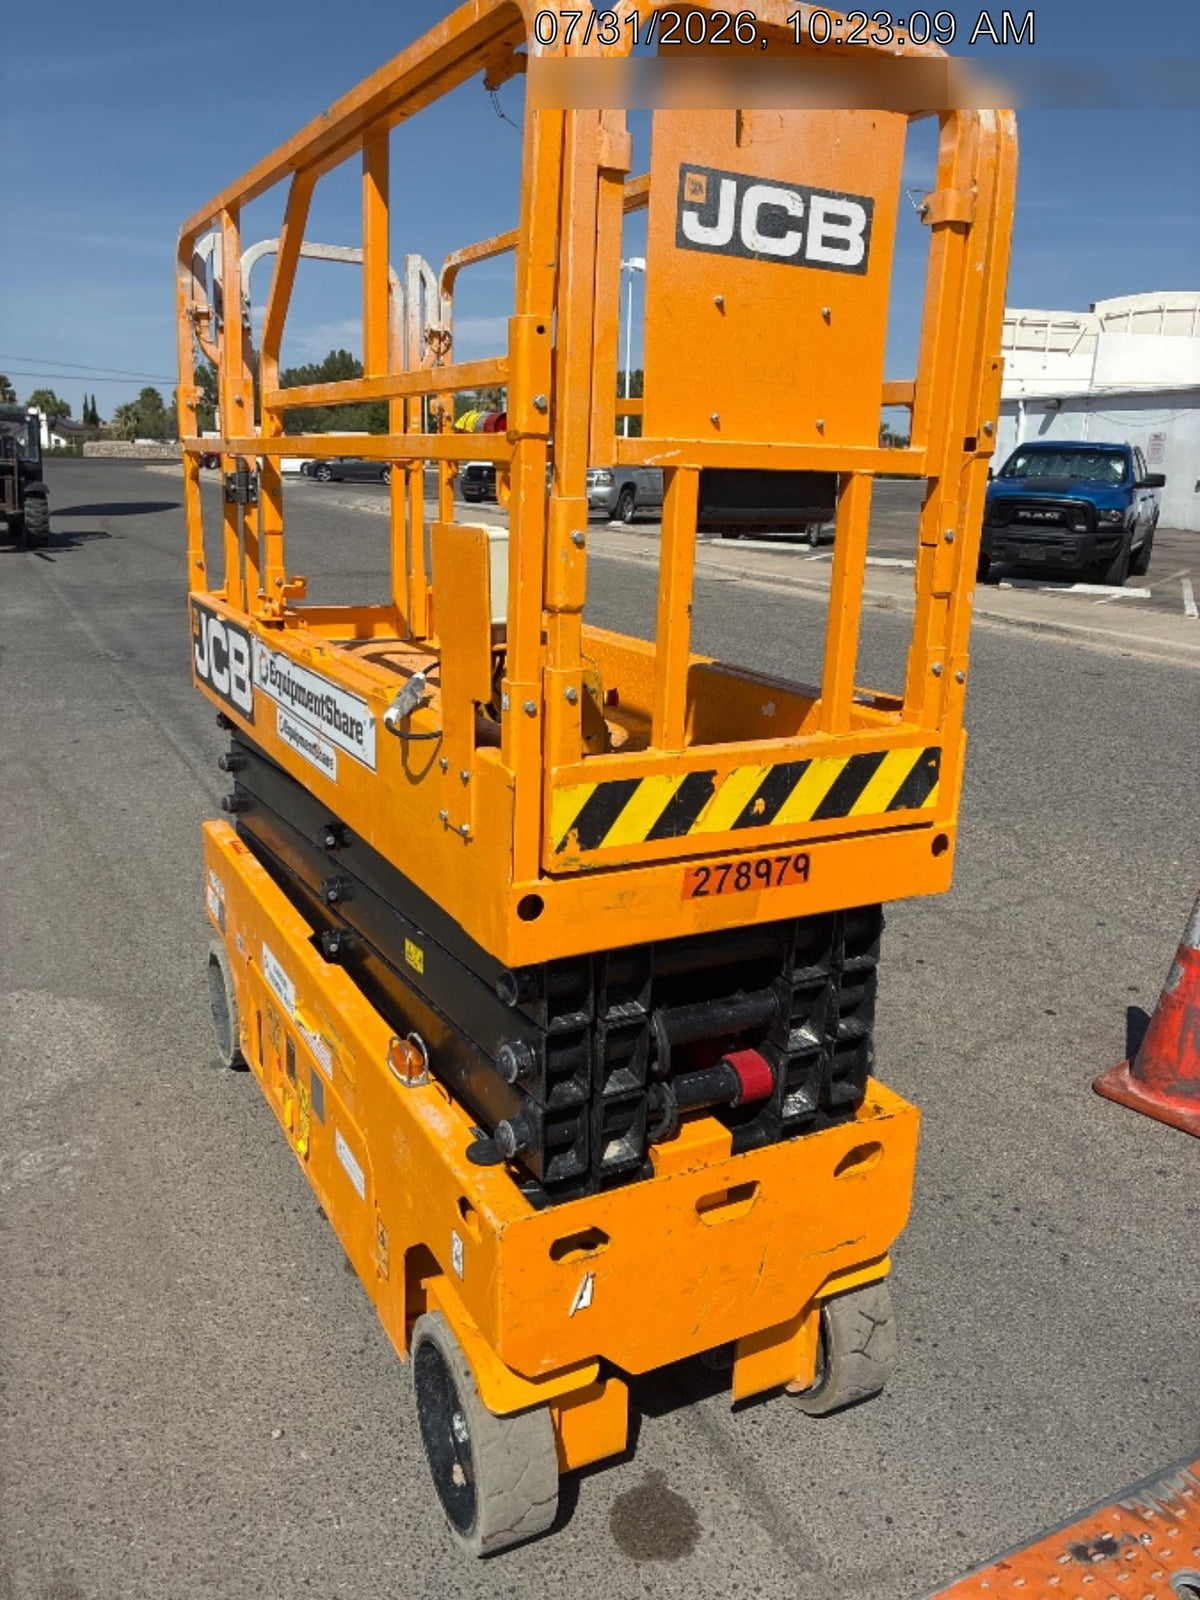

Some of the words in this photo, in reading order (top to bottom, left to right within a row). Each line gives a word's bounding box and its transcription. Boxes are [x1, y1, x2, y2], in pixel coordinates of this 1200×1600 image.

[681, 177, 868, 267] JCB
[195, 611, 253, 715] JCB
[269, 658, 363, 746] EquipmentShare
[691, 853, 810, 897] 278979
